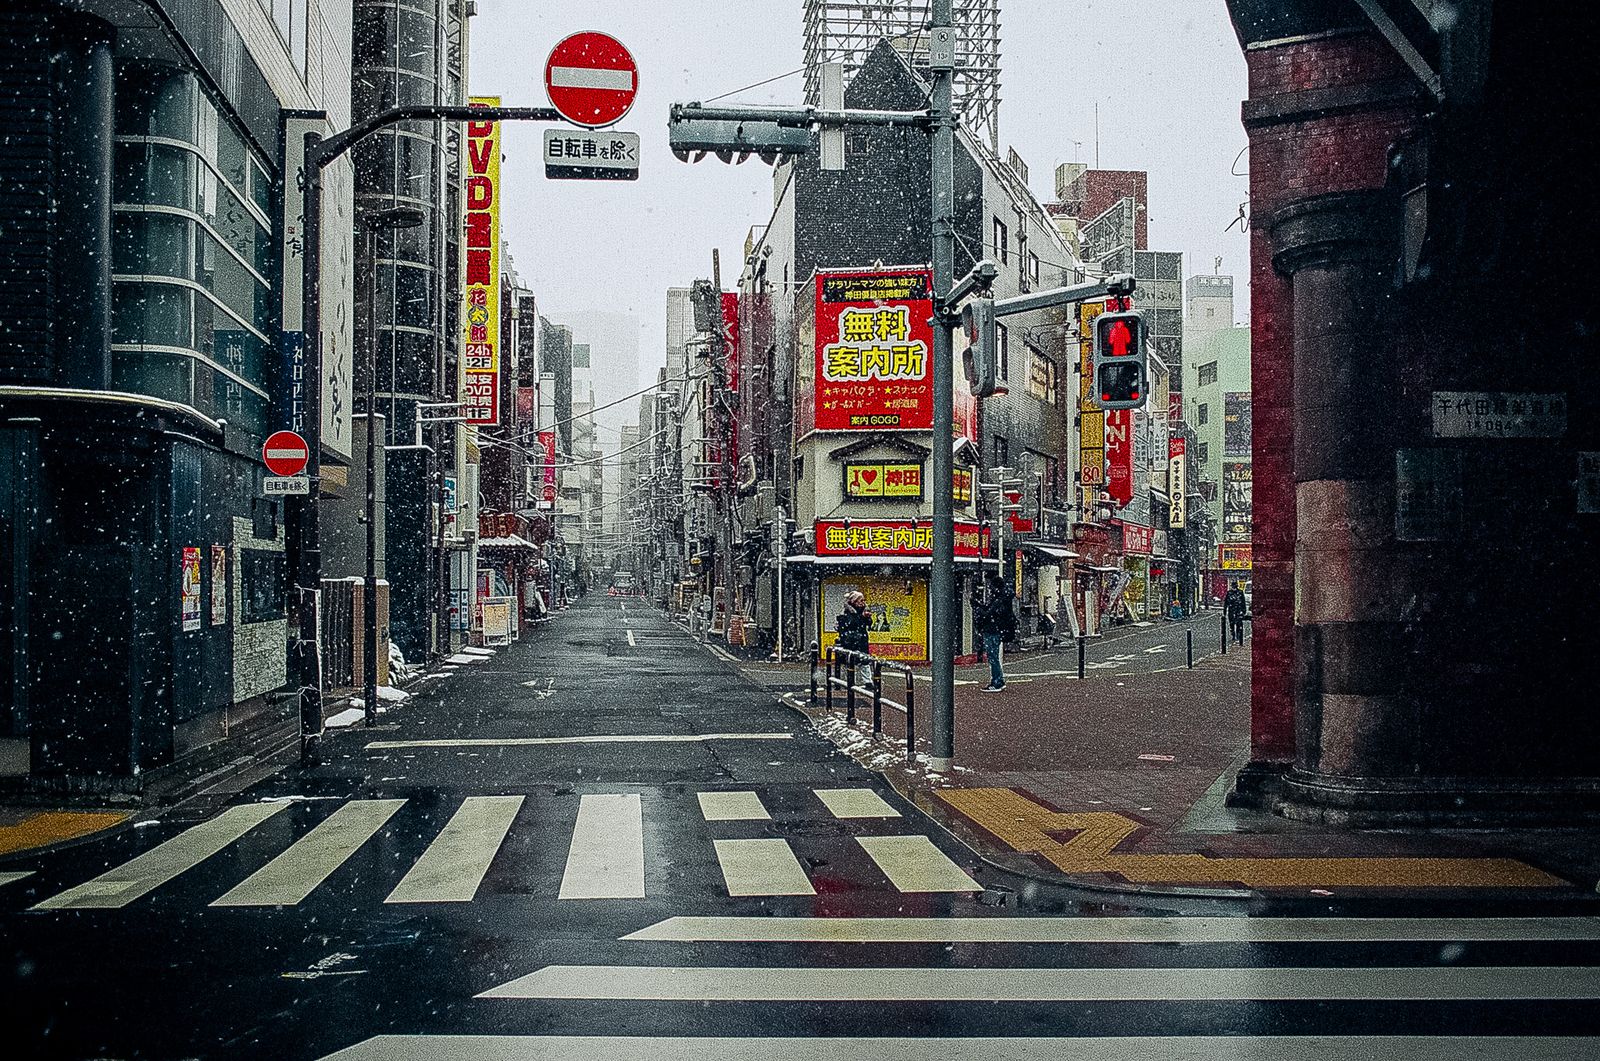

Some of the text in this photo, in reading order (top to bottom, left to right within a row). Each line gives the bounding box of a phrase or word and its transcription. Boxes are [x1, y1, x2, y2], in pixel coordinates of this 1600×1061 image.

[549, 137, 635, 160] 自転車を除く
[843, 309, 907, 342] 無料
[467, 345, 490, 356] 24h
[827, 344, 923, 377] 案内所
[851, 415, 899, 425] 案内 GOGO
[266, 481, 307, 491] 自転車を除く
[885, 469, 919, 486] 神田
[826, 527, 933, 549] 無料案内所
